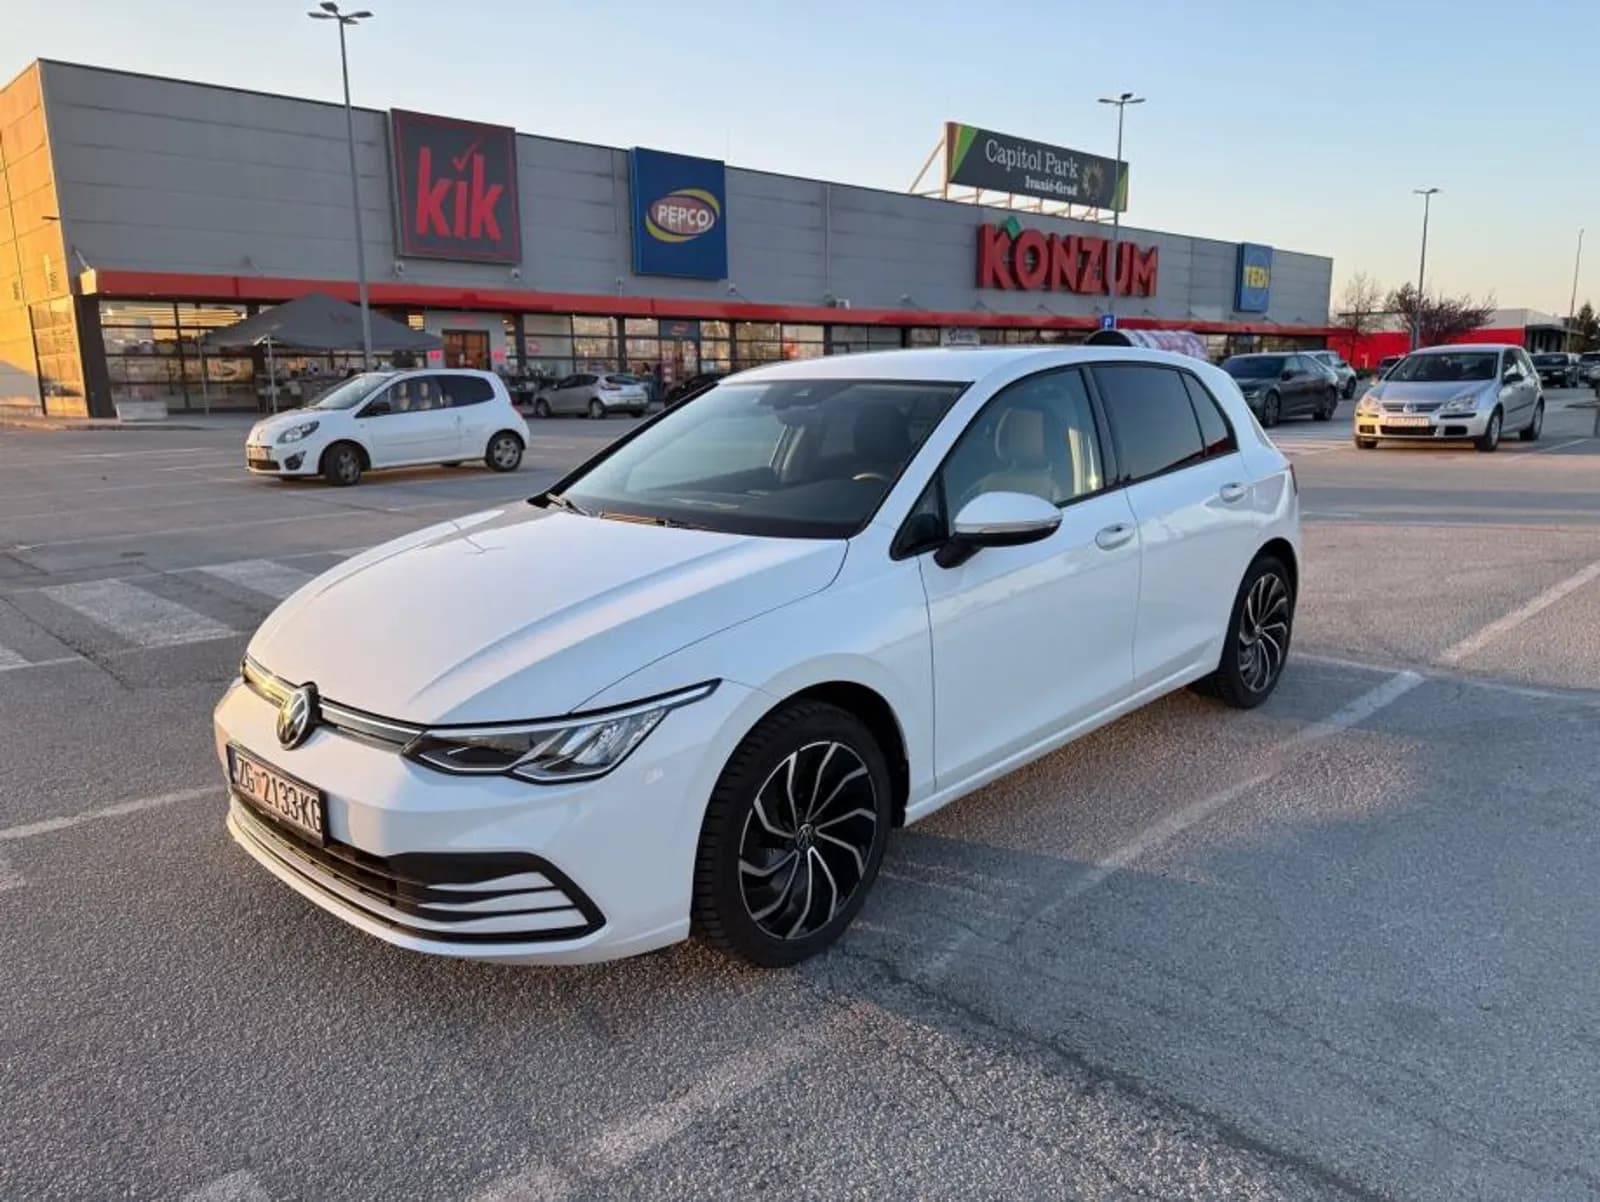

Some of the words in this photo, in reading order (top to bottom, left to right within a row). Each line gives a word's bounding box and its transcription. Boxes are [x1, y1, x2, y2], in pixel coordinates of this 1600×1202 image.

[985, 139, 1041, 172] Capitol
[1045, 152, 1079, 179] Park
[416, 142, 503, 241] kik
[658, 204, 710, 227] PEPCO
[976, 222, 1159, 298] KONZUM
[238, 757, 255, 793] ZG
